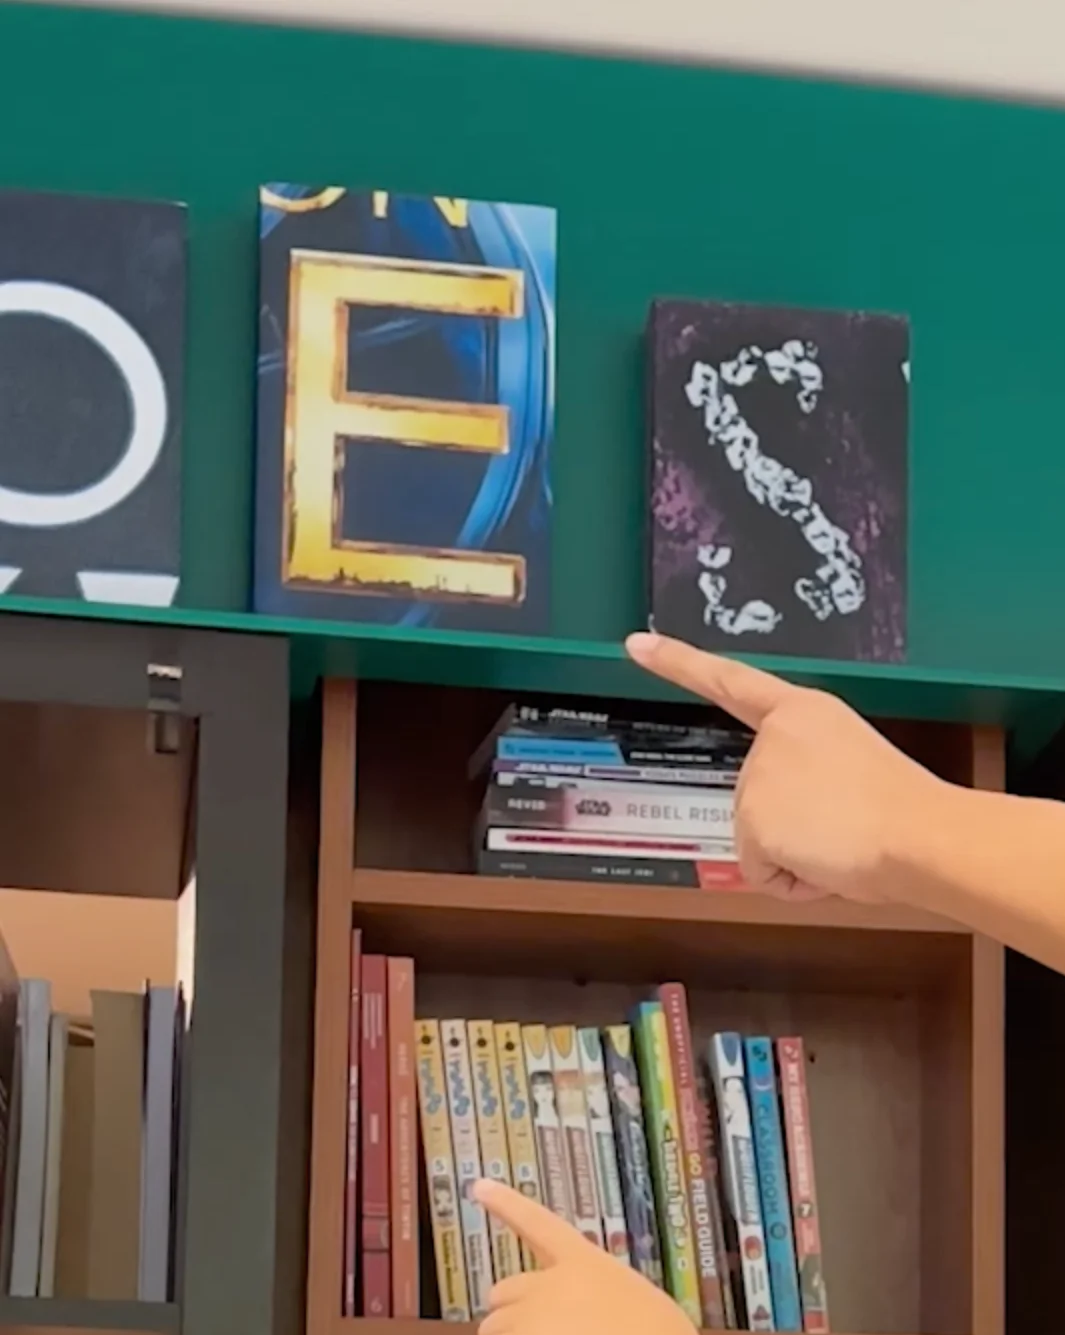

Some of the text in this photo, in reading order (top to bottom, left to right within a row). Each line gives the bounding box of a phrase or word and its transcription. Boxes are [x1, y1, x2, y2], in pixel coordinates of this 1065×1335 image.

[281, 249, 527, 604] E
[684, 338, 868, 637] S
[627, 803, 682, 820] REBEL
[690, 1178, 710, 1225] FIELD
[698, 1227, 716, 1277] GUIDE
